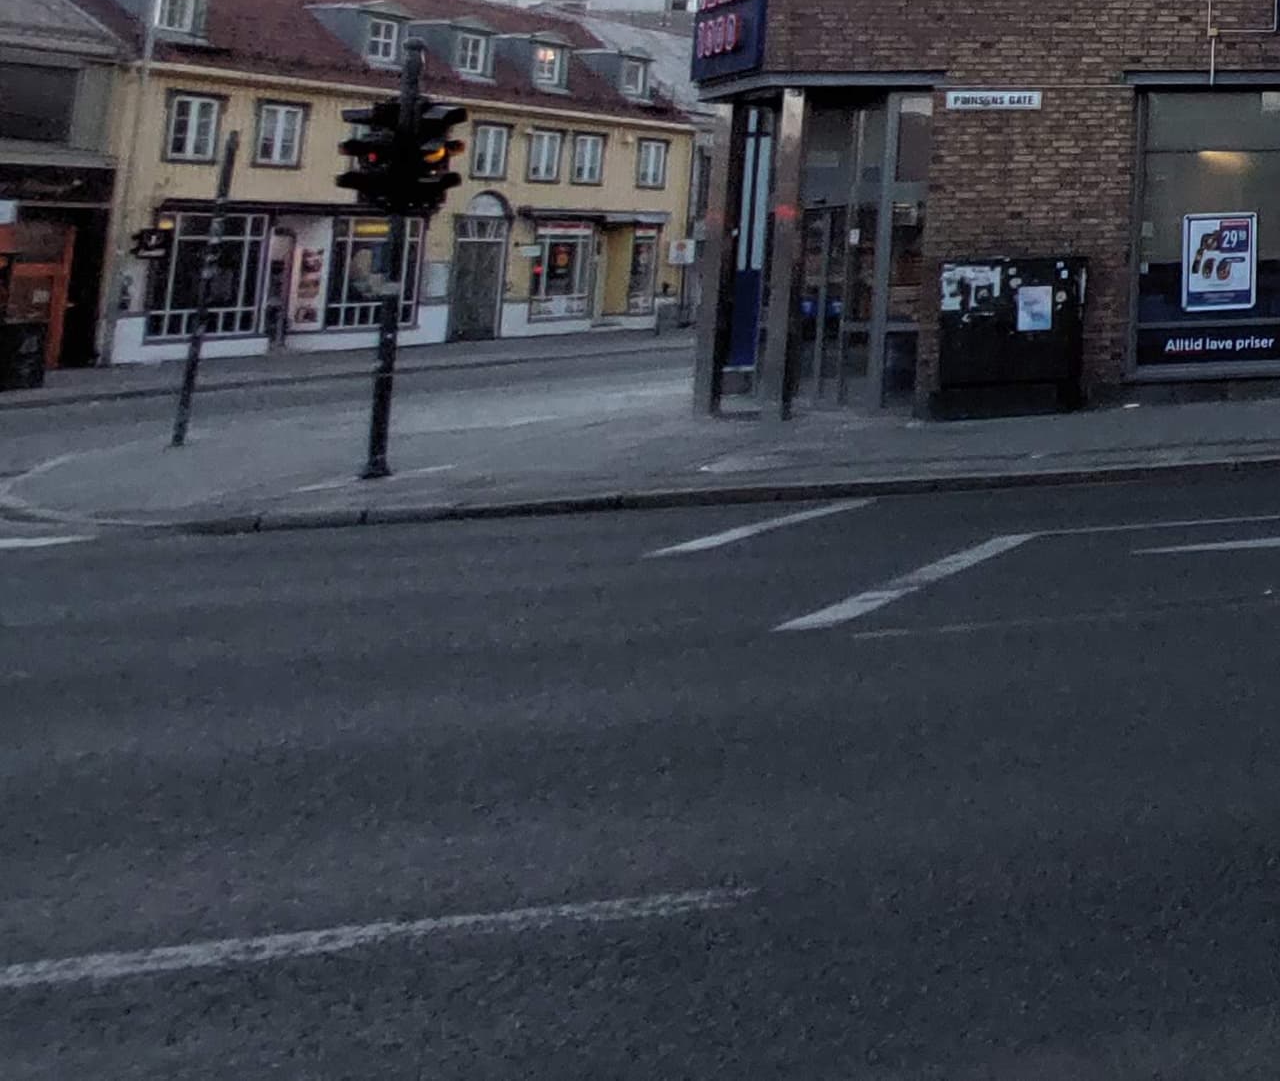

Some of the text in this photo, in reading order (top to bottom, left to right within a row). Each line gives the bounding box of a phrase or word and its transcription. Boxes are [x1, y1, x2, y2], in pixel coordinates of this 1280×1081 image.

[1009, 95, 1034, 106] GATE
[1164, 336, 1275, 352] Alltid lave priser
